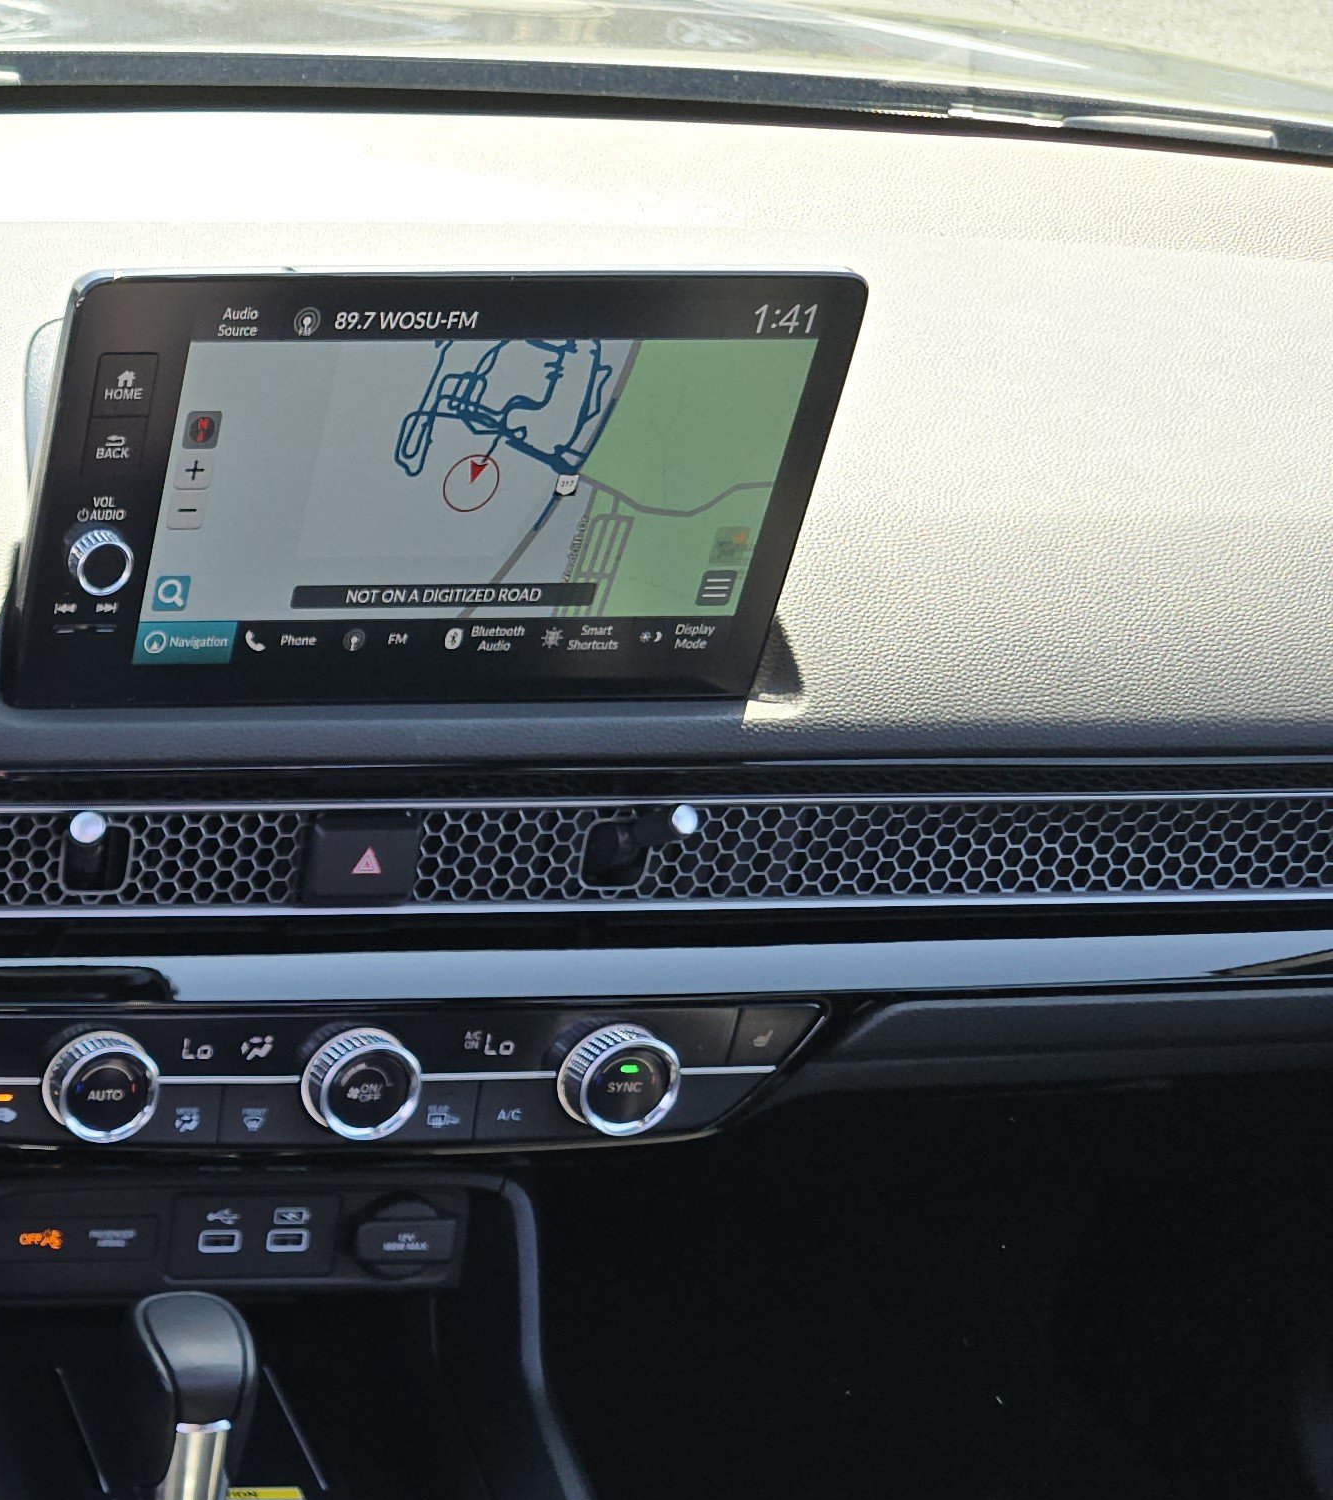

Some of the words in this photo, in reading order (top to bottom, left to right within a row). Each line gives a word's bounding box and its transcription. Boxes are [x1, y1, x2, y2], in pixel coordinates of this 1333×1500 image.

[223, 306, 260, 321] Audio
[334, 311, 375, 330] 89.7
[379, 310, 479, 329] WOSU-FM
[754, 304, 818, 334] 1:41
[217, 323, 259, 338] Source
[104, 388, 144, 401] HOME
[95, 447, 130, 460] BACK
[93, 496, 115, 508] VOL
[90, 509, 126, 521] AUDIO
[346, 589, 381, 604] NOT
[382, 589, 406, 603] ON
[407, 589, 421, 603] A
[421, 588, 497, 603] DIGITIZED
[498, 587, 542, 602] ROAD
[471, 624, 526, 637] Bluetooth
[580, 624, 614, 637] Smart
[674, 623, 716, 637] Display
[169, 635, 228, 649] Navigation
[280, 634, 317, 647] Phone
[387, 633, 408, 645] FM
[567, 638, 619, 651] Shortcuts
[674, 637, 708, 650] Mode
[477, 640, 511, 652] Audio
[464, 1029, 483, 1041] A/C
[181, 1037, 214, 1060] Lo
[464, 1040, 482, 1050] ON
[484, 1033, 515, 1056] Lo
[360, 1082, 383, 1094] ON/
[606, 1081, 643, 1094] SYNC
[87, 1089, 125, 1102] AUTO
[358, 1092, 381, 1103] OFF
[497, 1107, 524, 1122] A/C
